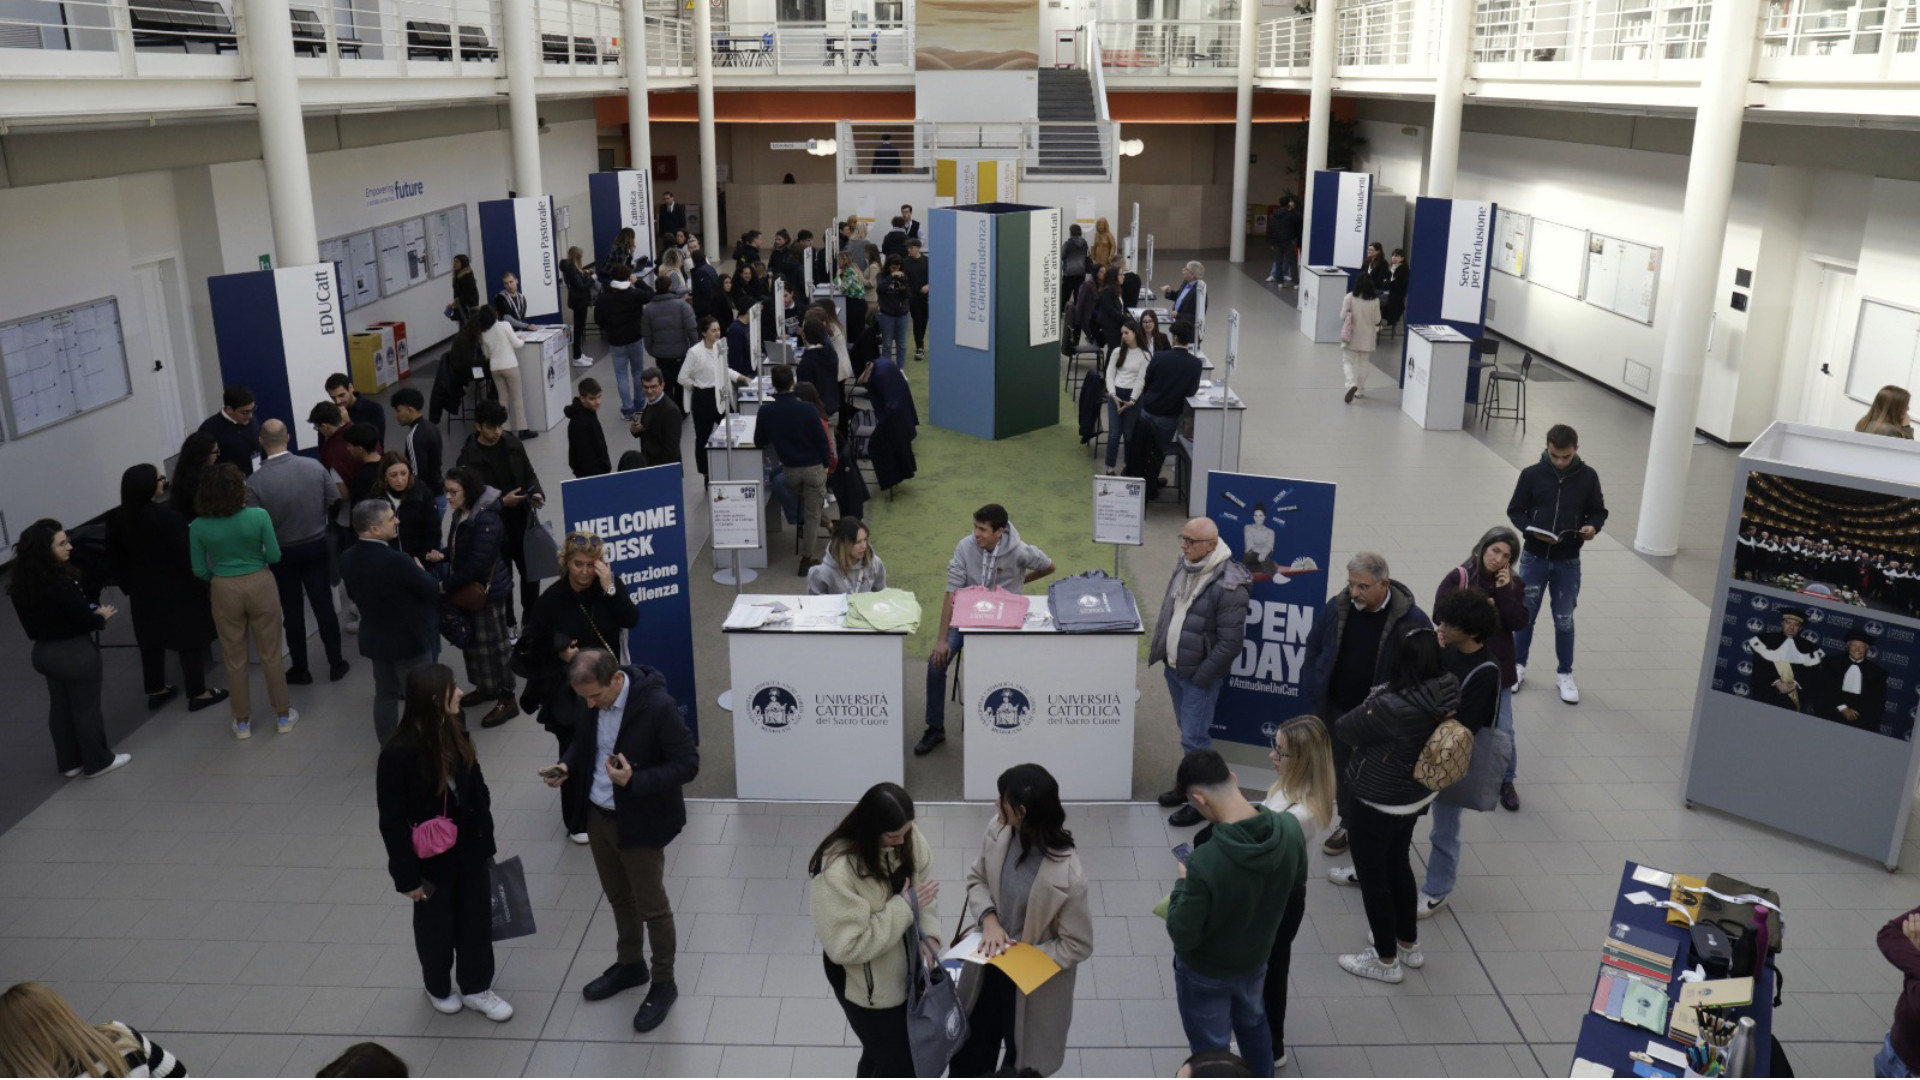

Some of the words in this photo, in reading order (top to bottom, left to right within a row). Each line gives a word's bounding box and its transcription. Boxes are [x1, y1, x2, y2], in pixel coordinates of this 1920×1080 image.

[395, 180, 423, 200] future
[1356, 176, 1366, 212] studenti
[630, 190, 638, 226] Cattolica
[537, 200, 550, 248] Pastorale
[1354, 213, 1362, 232] Polo
[542, 251, 552, 286] Centro
[978, 219, 987, 311] Giurisprudenza
[1459, 252, 1472, 287] Servizi
[1051, 274, 1057, 282] e
[1471, 270, 1480, 288] per
[315, 270, 336, 336] EDUCatt
[968, 262, 978, 322] Economia
[574, 504, 676, 539] WELCOME
[602, 534, 655, 564] DESK
[618, 564, 678, 586] trazione
[629, 583, 679, 606] glienza
[1243, 598, 1314, 645] PEN
[1230, 638, 1307, 684] DAY
[1229, 676, 1300, 697] #AttitudineUniCatt
[815, 692, 888, 705] UNIVERSITÀ
[1048, 692, 1121, 705] UNIVERSITÀ
[815, 705, 888, 717] CATTOLICA
[816, 717, 830, 725] del
[833, 717, 858, 725] Sacro
[861, 717, 888, 725] Cuore
[1048, 705, 1121, 717] CATTOLICA
[1048, 716, 1062, 725] del
[1065, 716, 1090, 725] Sacro
[1092, 716, 1120, 725] Cuore
